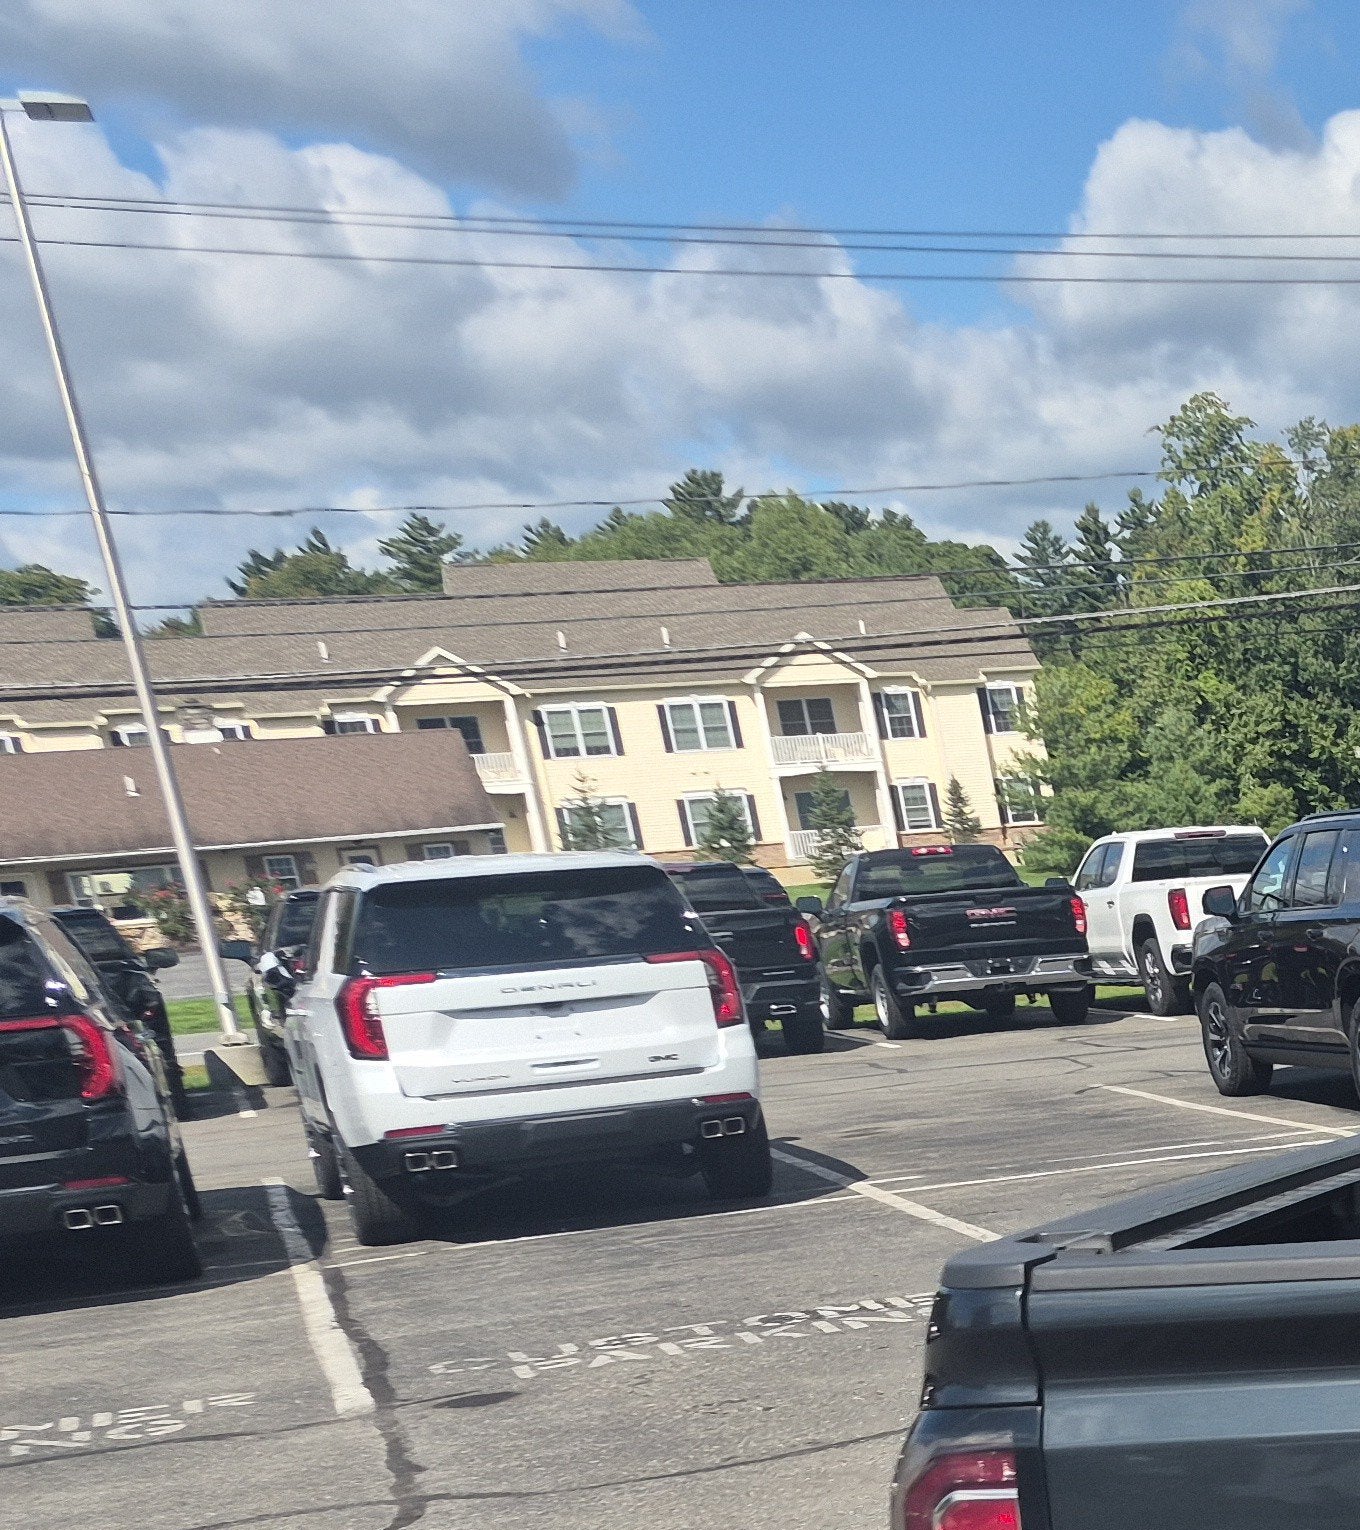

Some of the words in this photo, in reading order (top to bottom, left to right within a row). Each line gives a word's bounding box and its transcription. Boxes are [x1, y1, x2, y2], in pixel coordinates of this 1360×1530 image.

[500, 980, 598, 994] DENALI
[428, 1292, 939, 1375] CUSTOME
[511, 1308, 938, 1379] PARKIN
